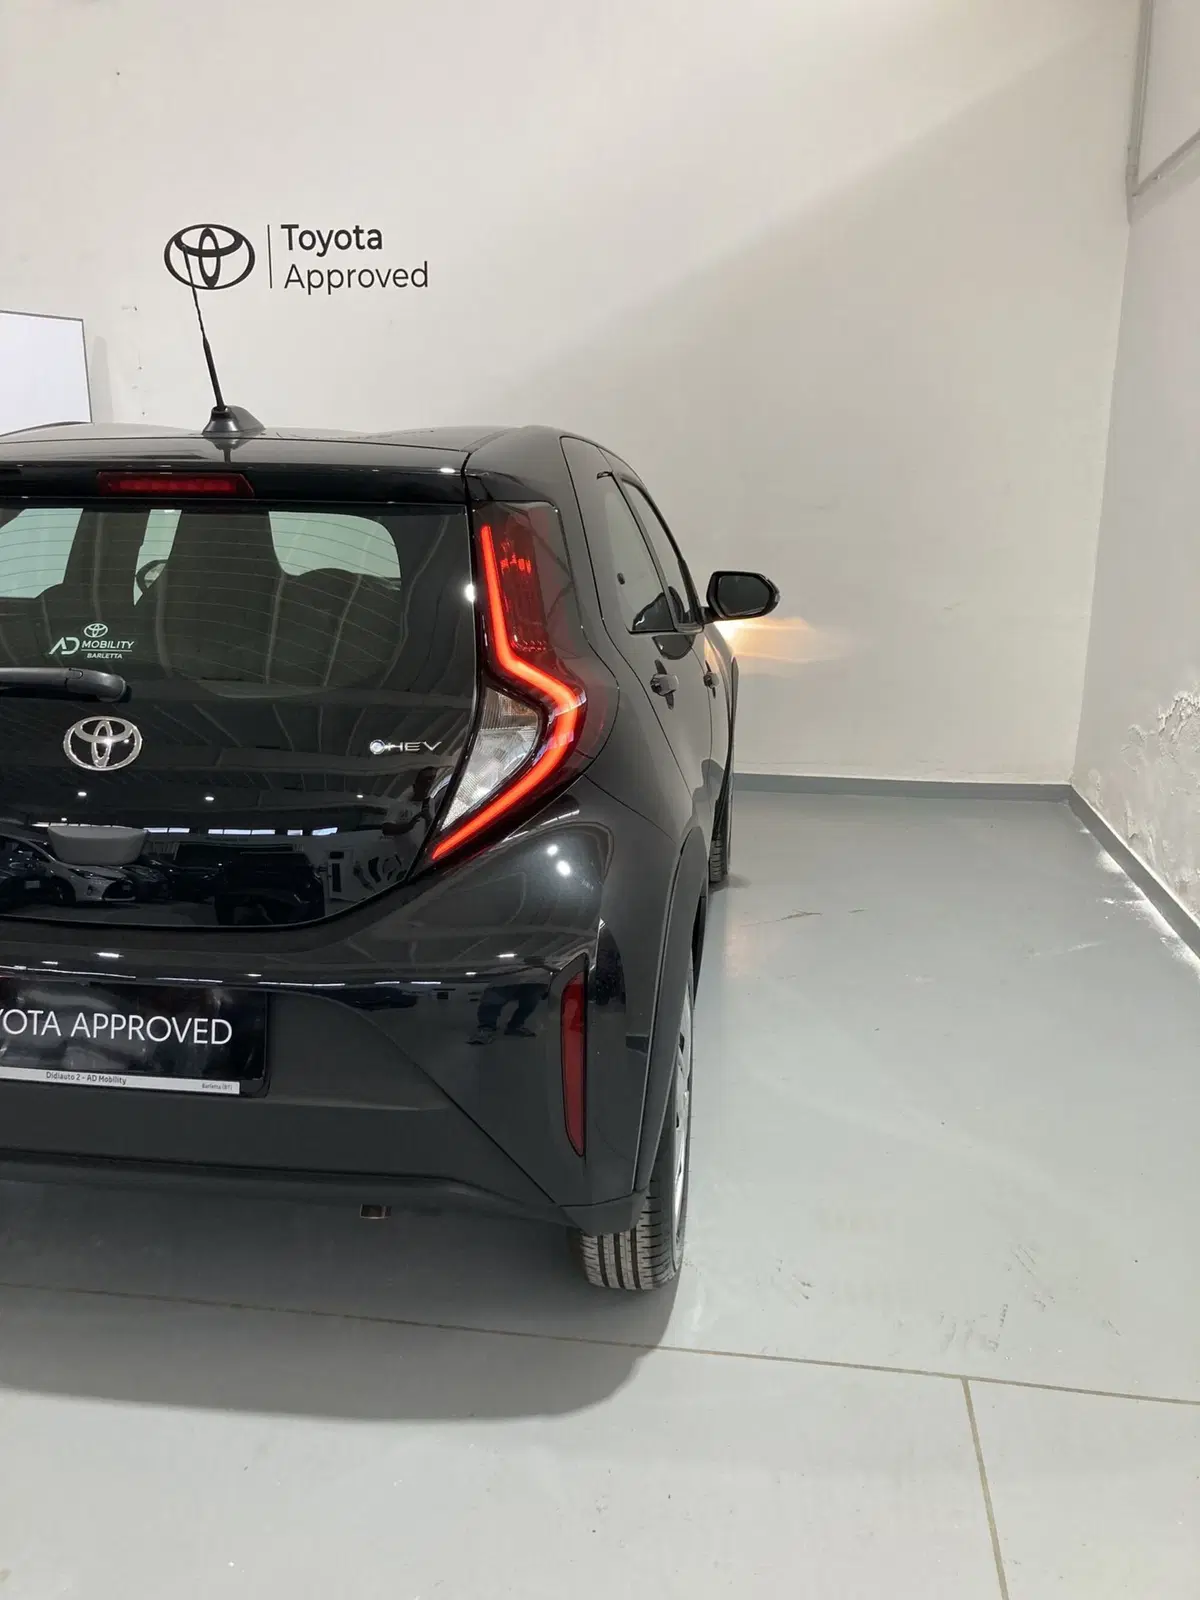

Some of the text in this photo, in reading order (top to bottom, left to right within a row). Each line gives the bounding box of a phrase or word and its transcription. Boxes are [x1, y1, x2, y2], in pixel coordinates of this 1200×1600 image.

[280, 224, 383, 257] Toyota
[284, 261, 429, 295] Approved
[49, 637, 135, 655] AD MOBILITY
[387, 741, 442, 752] HEV
[70, 1011, 233, 1045] APPROVED
[76, 1073, 81, 1081] 2
[87, 1074, 98, 1082] AD
[99, 1075, 127, 1085] Mobility
